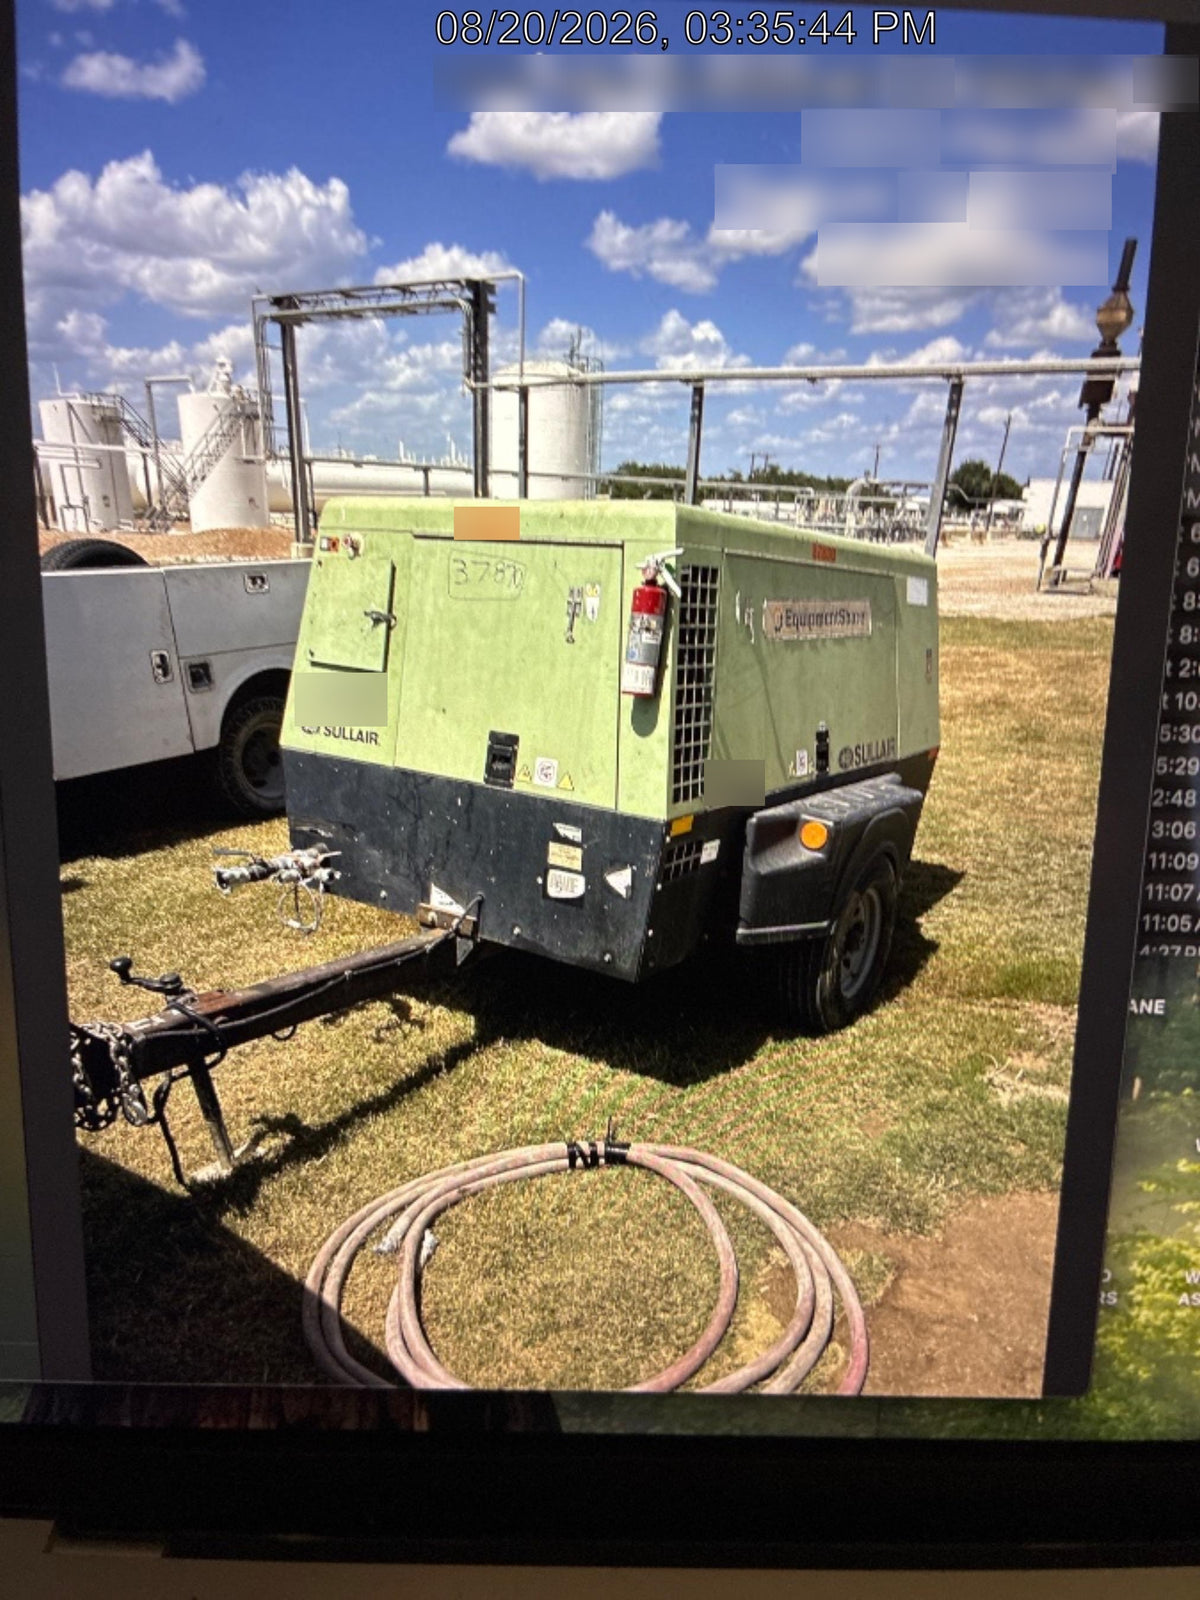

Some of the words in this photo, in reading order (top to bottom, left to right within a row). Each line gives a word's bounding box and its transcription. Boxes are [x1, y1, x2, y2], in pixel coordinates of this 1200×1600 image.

[323, 725, 379, 745] SULLAIR
[1156, 756, 1200, 776] 5:29
[1152, 788, 1196, 808] 2:48
[1152, 820, 1196, 839] 3:06
[1149, 852, 1198, 871] 11:09
[1145, 883, 1194, 902] 11:07
[1142, 914, 1192, 933] 11:05
